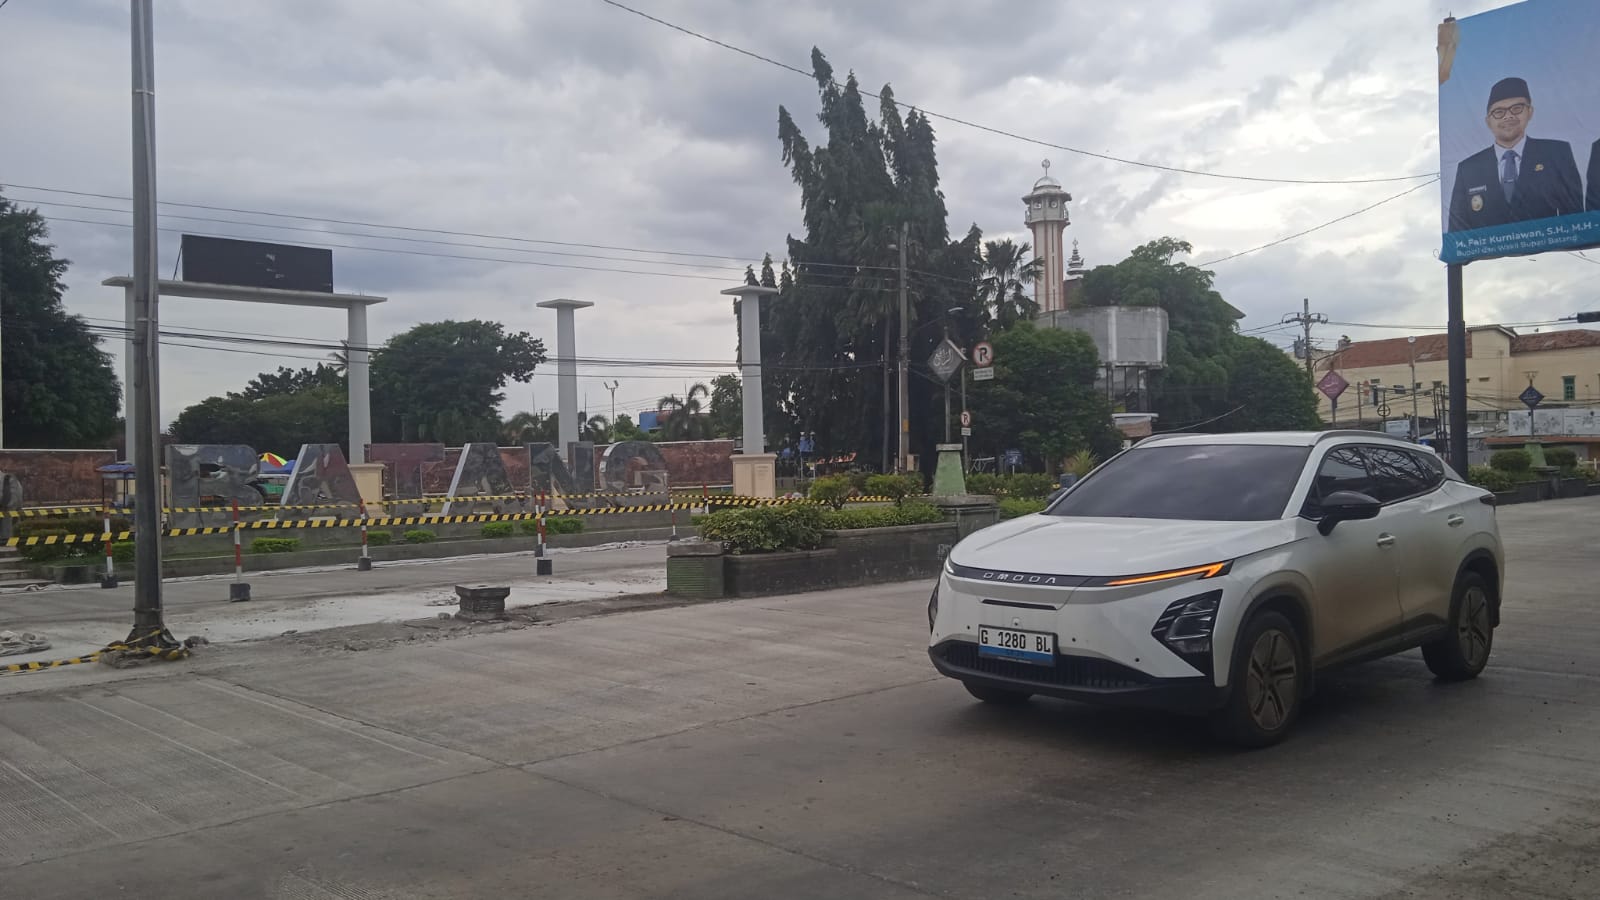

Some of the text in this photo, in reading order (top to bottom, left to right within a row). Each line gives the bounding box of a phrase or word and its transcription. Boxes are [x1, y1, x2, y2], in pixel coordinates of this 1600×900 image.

[1468, 238, 1487, 247] Faiz
[1489, 230, 1545, 244] Kurniawan,
[1482, 246, 1496, 254] dan
[1520, 239, 1546, 250] Bupati
[165, 441, 668, 528] BATANG
[983, 572, 1056, 584] OMODA
[980, 629, 988, 645] G
[998, 631, 1026, 650] 1280
[1036, 636, 1051, 653] BL
